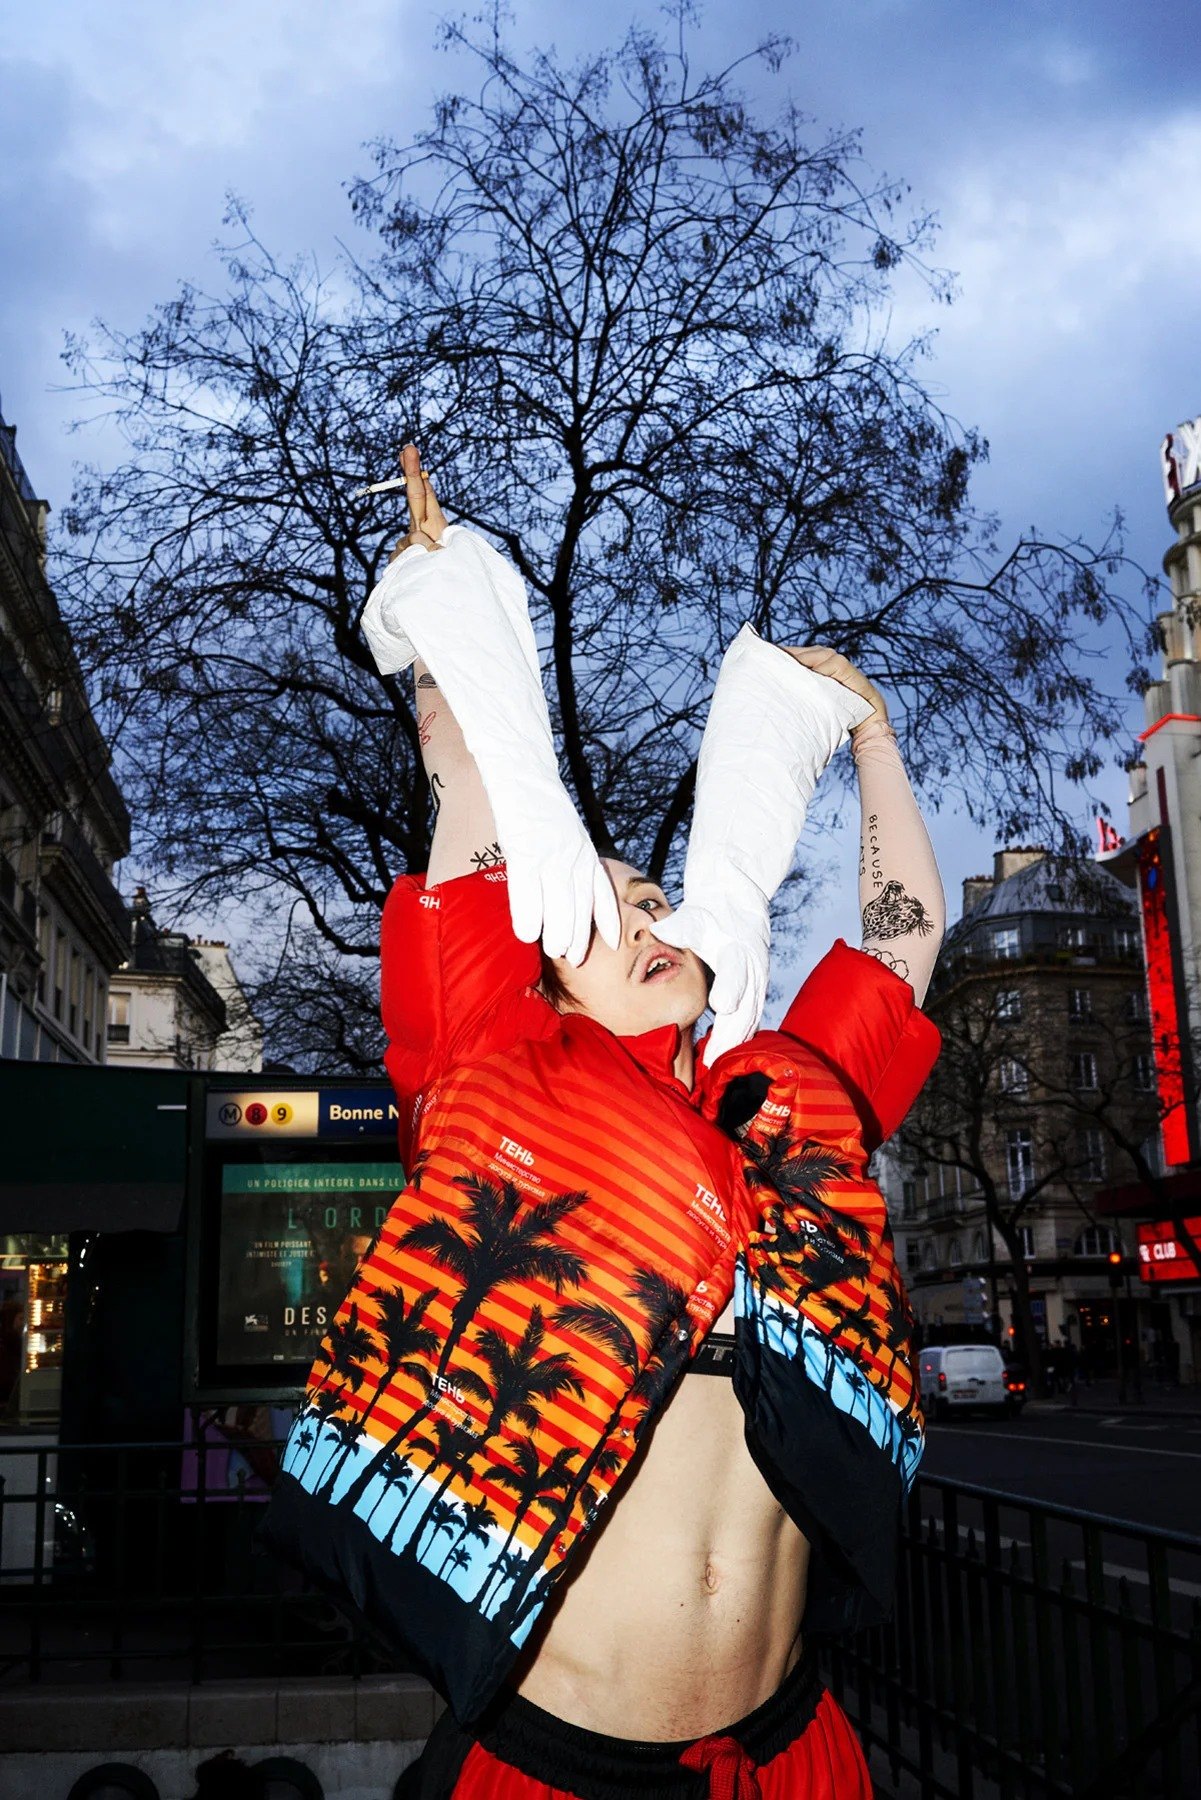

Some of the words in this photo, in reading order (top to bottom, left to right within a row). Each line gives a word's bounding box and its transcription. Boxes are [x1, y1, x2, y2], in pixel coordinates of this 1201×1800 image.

[869, 814, 883, 889] BECAUSE
[419, 895, 441, 910] НЬ
[329, 1104, 384, 1120] Bonne
[389, 1104, 399, 1119] N
[761, 1099, 791, 1117] ЕНЬ
[499, 1135, 535, 1167] ТЕНЬ
[359, 1177, 385, 1187] DANS
[389, 1177, 399, 1187] LE
[288, 1207, 387, 1229] L'ORD
[284, 1306, 327, 1326] DES
[430, 1372, 465, 1404] ТЕНЬ
